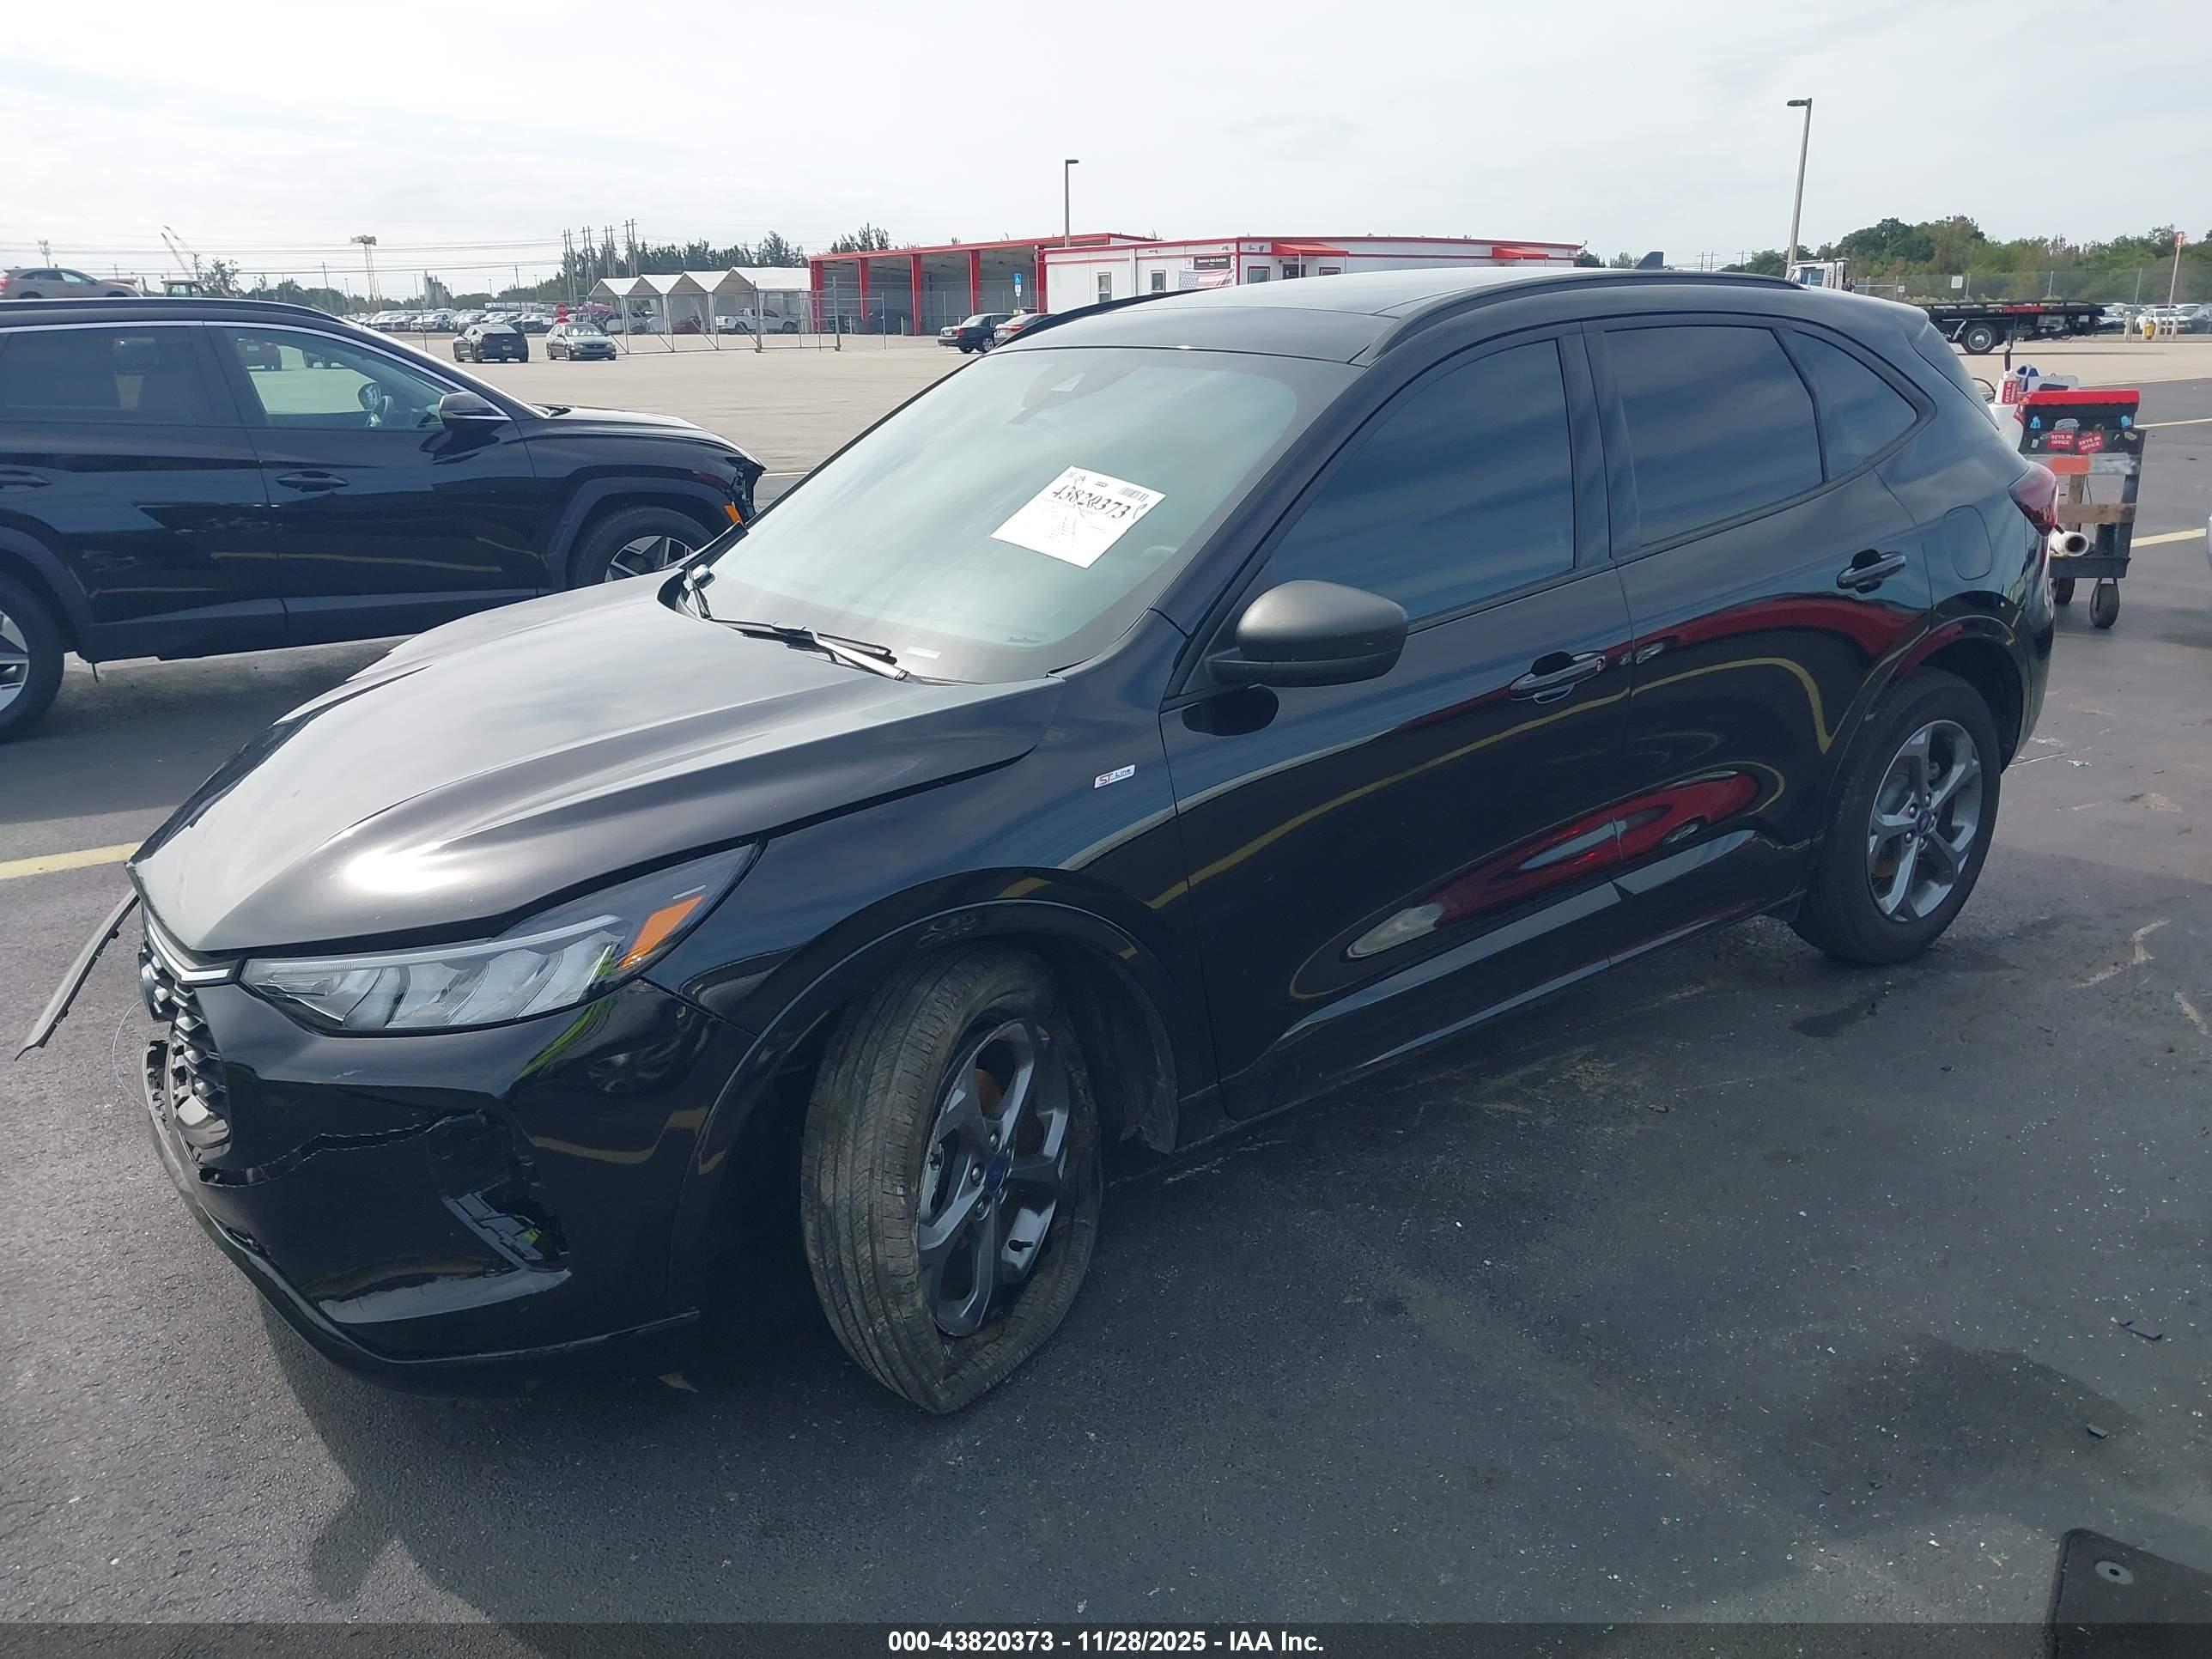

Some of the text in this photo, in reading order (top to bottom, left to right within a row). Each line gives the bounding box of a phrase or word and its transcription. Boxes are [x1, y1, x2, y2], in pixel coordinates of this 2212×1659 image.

[2078, 438, 2094, 447] KEYS
[2081, 441, 2100, 450] OFFICE
[1052, 484, 1132, 520] 43820373
